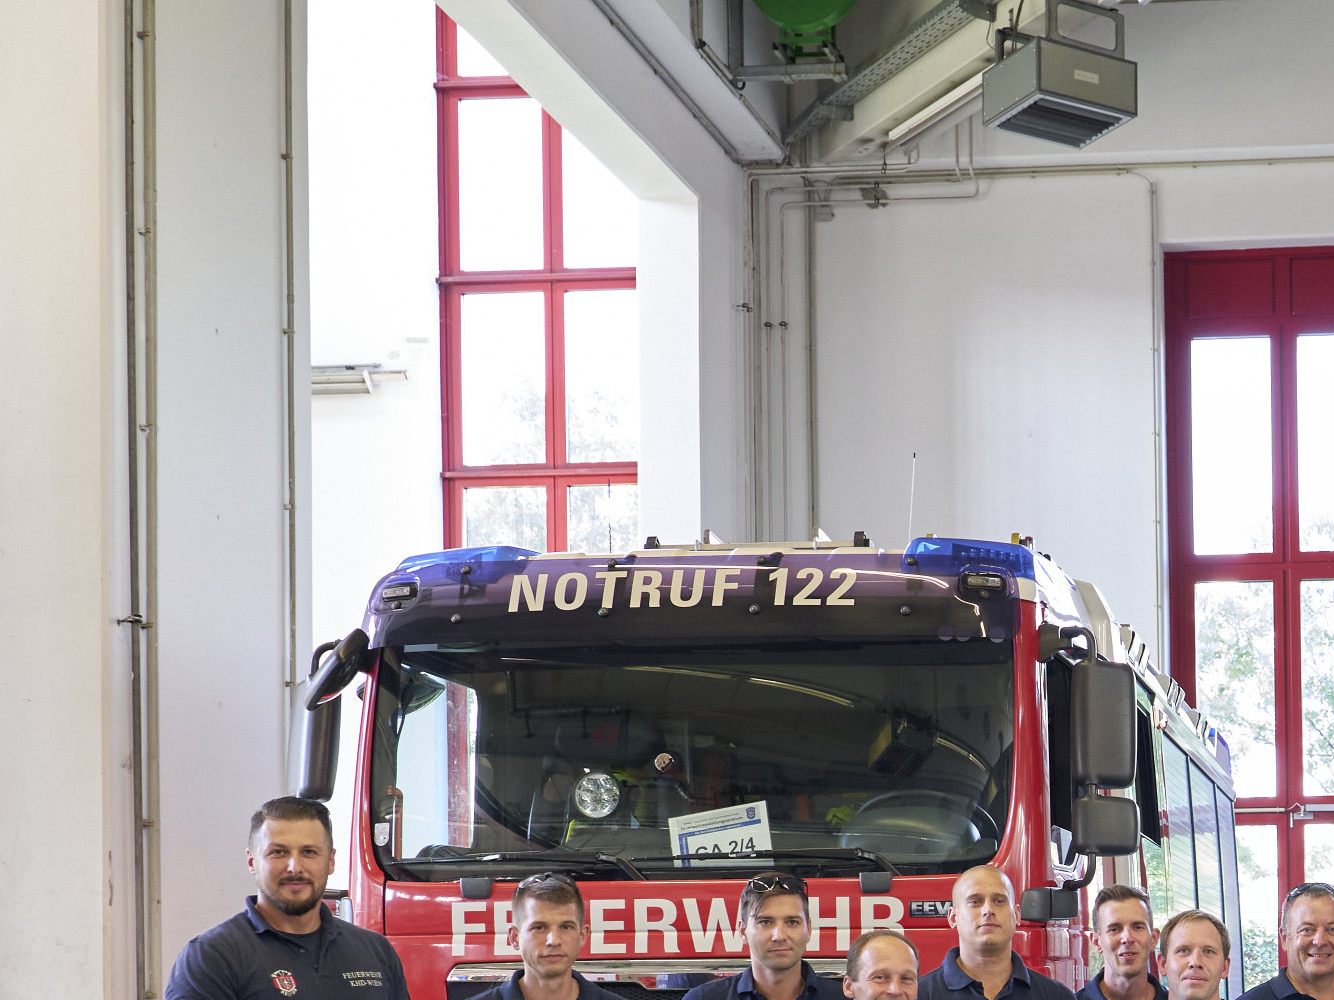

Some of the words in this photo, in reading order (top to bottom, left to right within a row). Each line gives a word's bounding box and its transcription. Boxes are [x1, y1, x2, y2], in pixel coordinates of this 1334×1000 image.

[507, 567, 741, 613] NOTRUF
[768, 566, 858, 607] 122
[728, 836, 756, 857] 2/4
[911, 901, 951, 915] EEV
[342, 971, 383, 979] FEUERWEHR
[349, 979, 383, 987] KHD-WIEN
